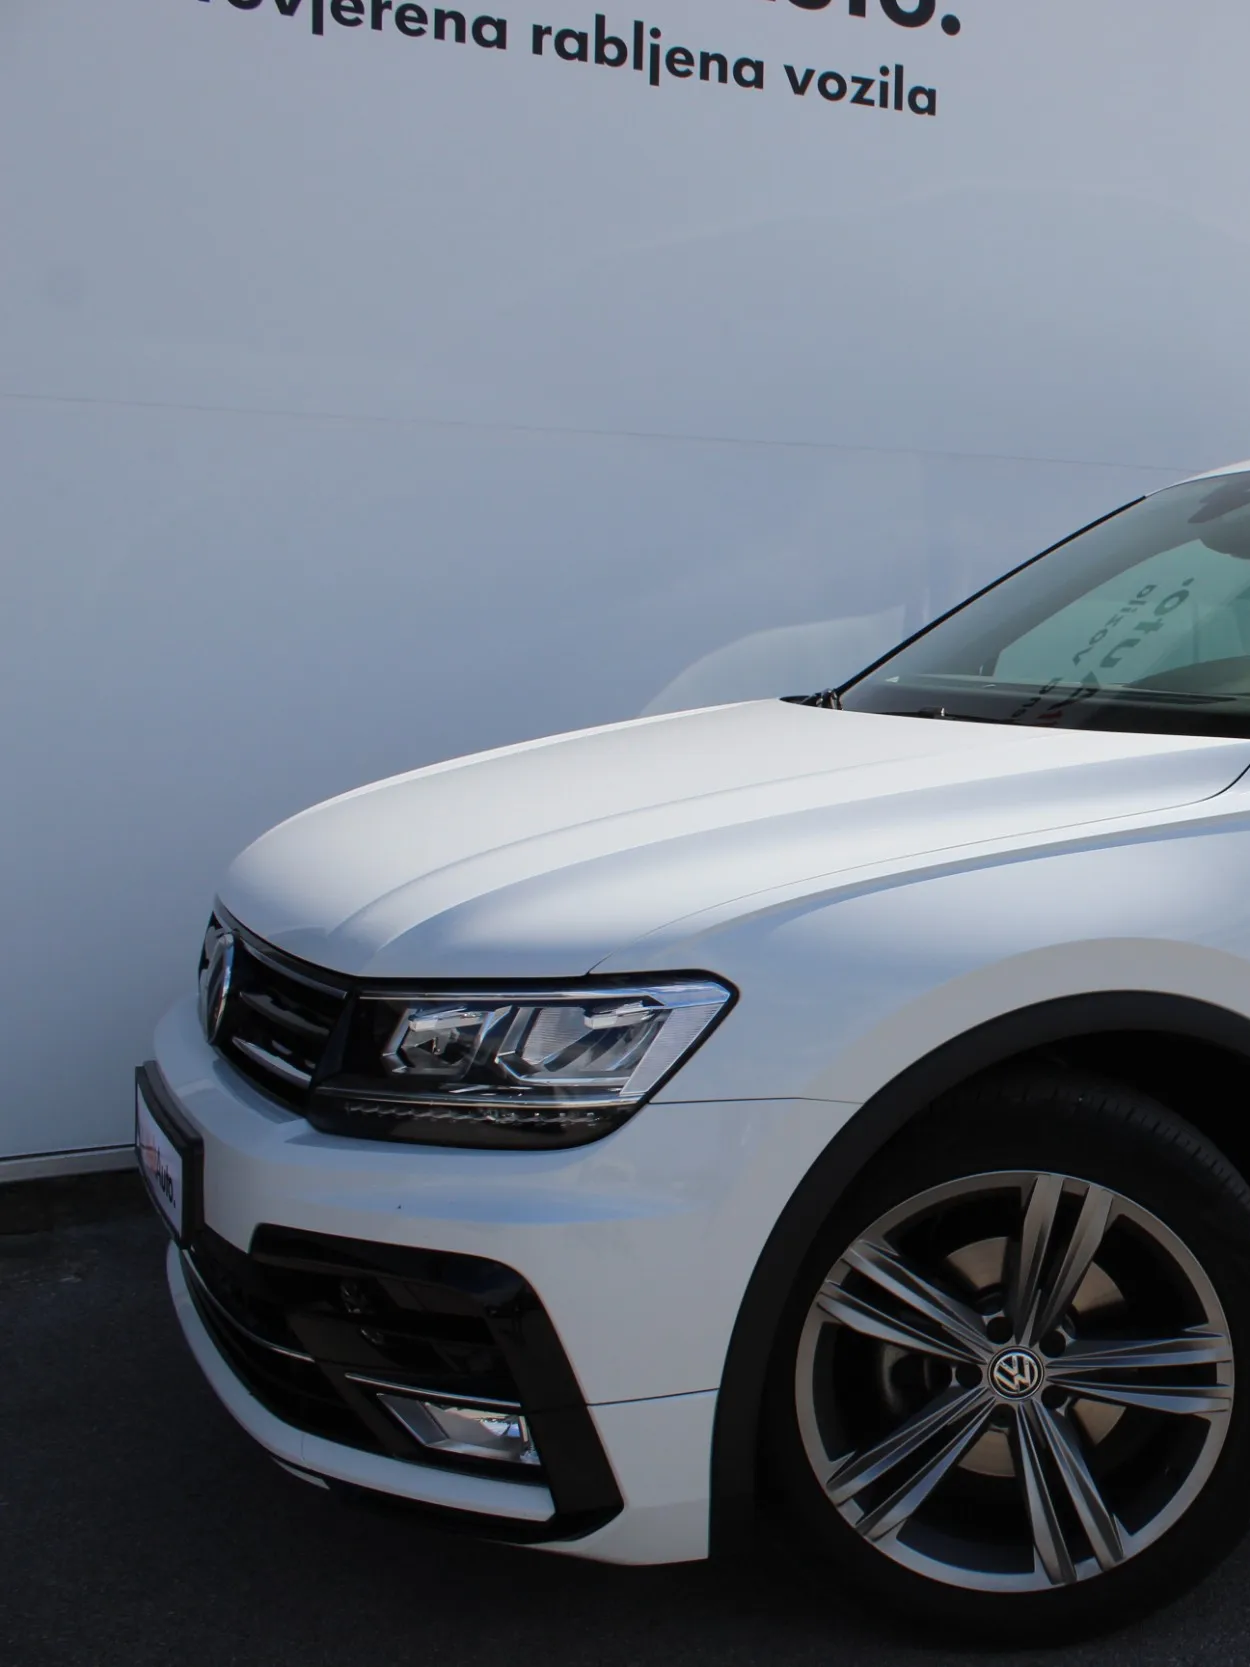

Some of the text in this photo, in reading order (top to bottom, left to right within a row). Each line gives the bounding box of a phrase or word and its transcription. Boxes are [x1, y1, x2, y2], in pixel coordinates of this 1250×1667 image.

[197, 0, 507, 50] jerena
[532, 13, 764, 90] rabljena
[783, 64, 937, 117] vozila
